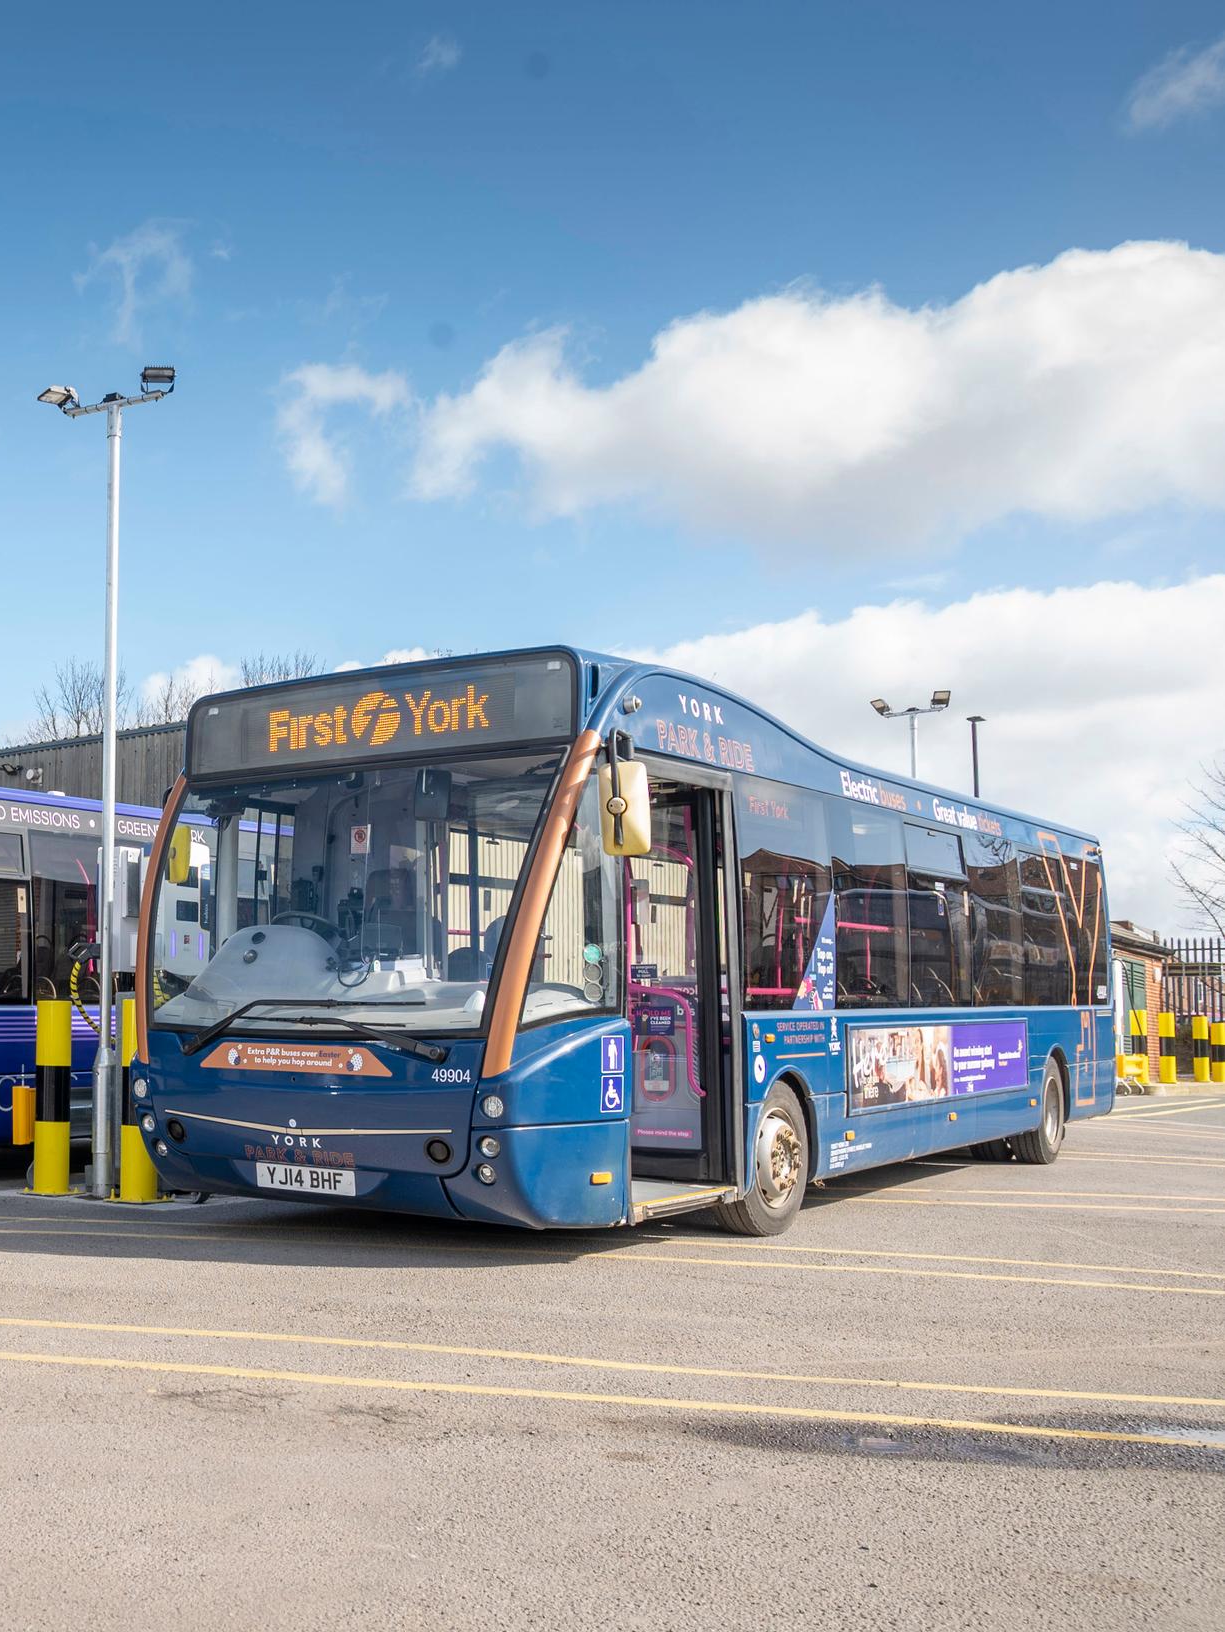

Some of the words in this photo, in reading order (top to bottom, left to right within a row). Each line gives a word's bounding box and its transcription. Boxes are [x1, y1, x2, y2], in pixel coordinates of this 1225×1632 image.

[269, 704, 348, 752] First
[404, 684, 490, 735] York
[678, 693, 724, 725] YORK
[656, 718, 702, 759] PARK
[702, 732, 717, 763] &
[718, 736, 755, 772] RIDE
[839, 770, 879, 804] Electric
[878, 782, 907, 811] buses
[11, 807, 81, 829] EMISSIONS
[932, 797, 957, 823] Great
[955, 805, 978, 831] value
[977, 811, 1003, 837] tickets
[776, 1021, 796, 1032] SERVICE
[796, 1021, 819, 1031] OPERATED
[247, 1046, 265, 1055] Extra
[265, 1047, 280, 1056] P&R
[281, 1048, 301, 1057] buses
[318, 1049, 341, 1059] Easter
[262, 1055, 277, 1066] help
[277, 1058, 291, 1066] you
[291, 1057, 306, 1067] hop
[306, 1058, 333, 1067] around
[431, 1068, 471, 1083] 49904
[271, 1134, 322, 1149] YORK
[244, 1144, 288, 1162] PARK
[293, 1148, 307, 1164] &
[312, 1150, 356, 1168] RIDE
[266, 1166, 305, 1187] YJ14
[309, 1170, 344, 1191] BHF
